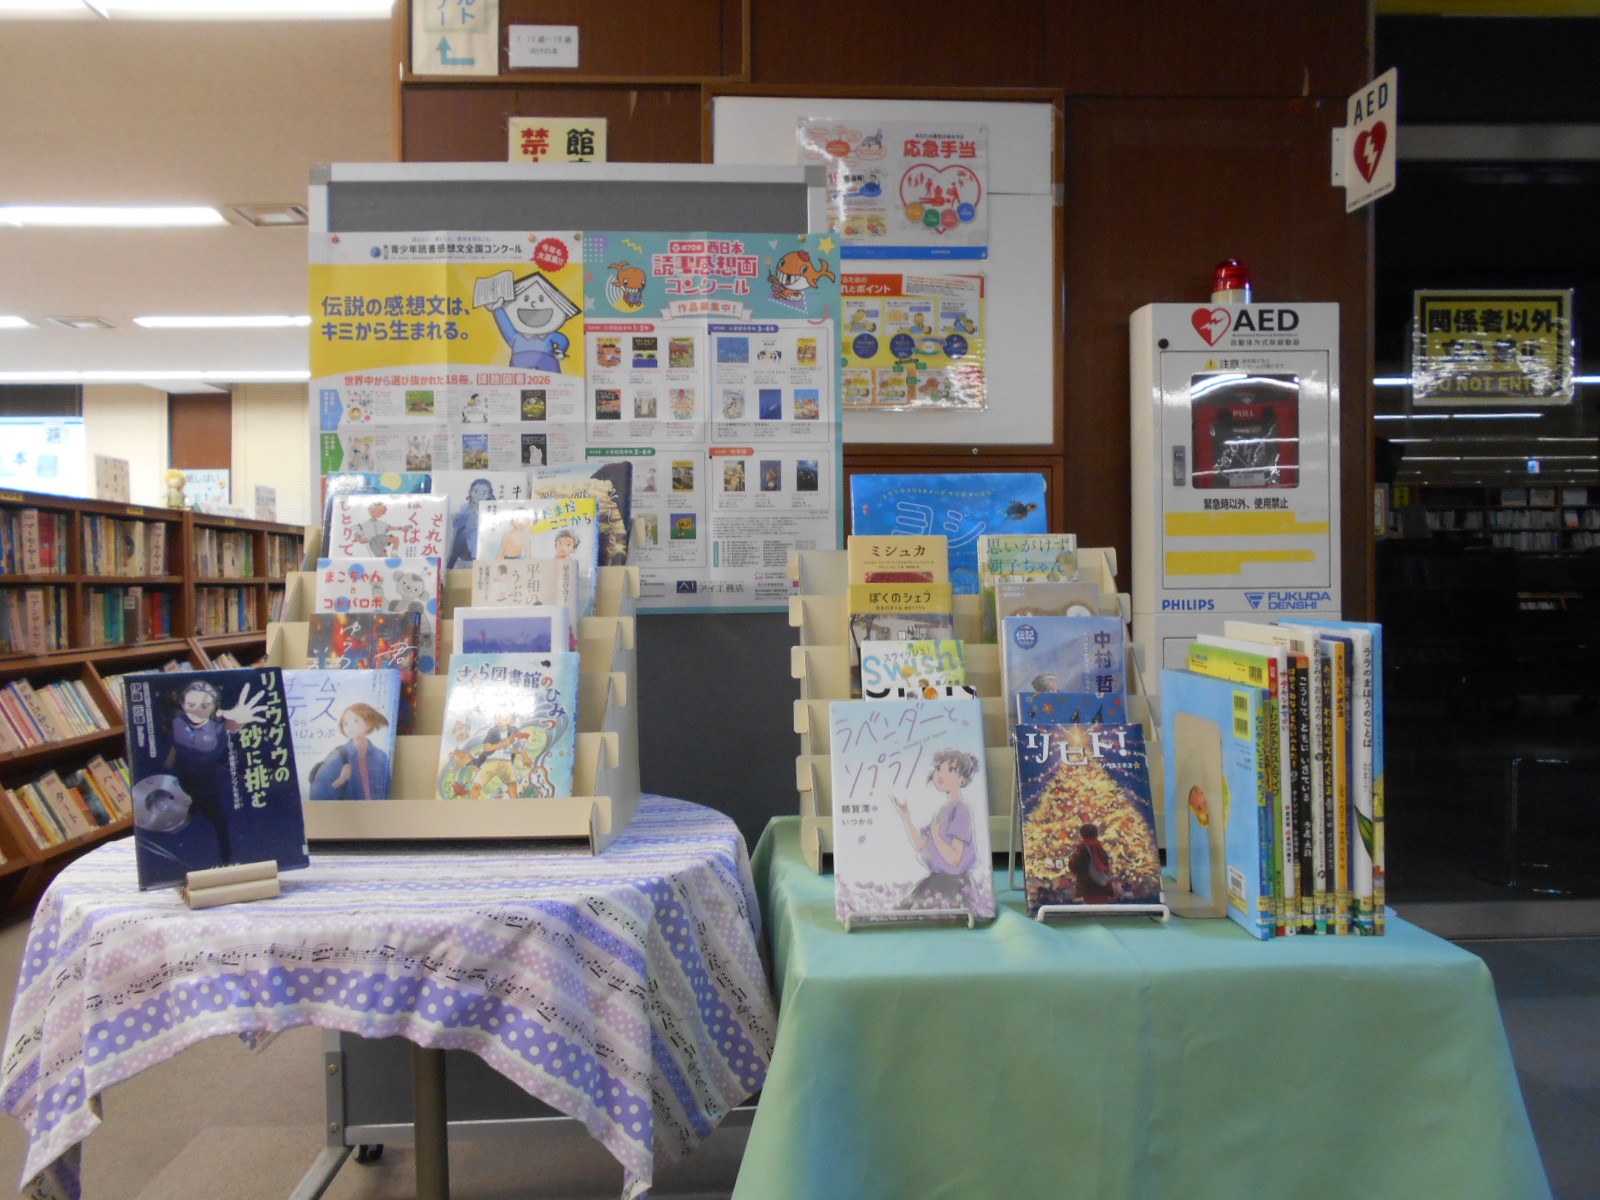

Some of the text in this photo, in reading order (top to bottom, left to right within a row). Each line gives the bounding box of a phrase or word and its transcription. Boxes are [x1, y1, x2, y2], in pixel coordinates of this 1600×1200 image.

[1354, 82, 1389, 125] AED
[903, 139, 977, 159] 応急手当
[391, 243, 522, 255] 青少年読書感想文全国コンクール
[707, 242, 744, 254] 西日本
[653, 255, 758, 276] 読書感想画
[665, 279, 750, 294] コンクール
[321, 296, 472, 316] 伝説の感想文は、
[1232, 309, 1299, 331] AED
[1428, 308, 1558, 333] 関係者以外
[321, 320, 470, 342] キミから生まれる。
[1219, 359, 1239, 369] 注意
[527, 376, 550, 385] 2026
[1455, 377, 1495, 392] NOT
[1232, 409, 1255, 418] PULL
[1204, 498, 1288, 509] 緊急時以外、使用禁止
[871, 545, 926, 558] ミシュカ
[325, 570, 384, 583] まこちゃん
[700, 582, 744, 593] アイ工務店
[869, 591, 931, 604] ぼくのシェフ
[1268, 591, 1331, 601] FUKUDA
[1162, 599, 1215, 611] PHILIPS
[1268, 601, 1318, 610] DENSHI
[1094, 630, 1113, 693] 中村哲
[260, 671, 290, 783] リュウグウの
[1025, 731, 1127, 766] リヒト!
[239, 724, 271, 808] 砂に挑む
